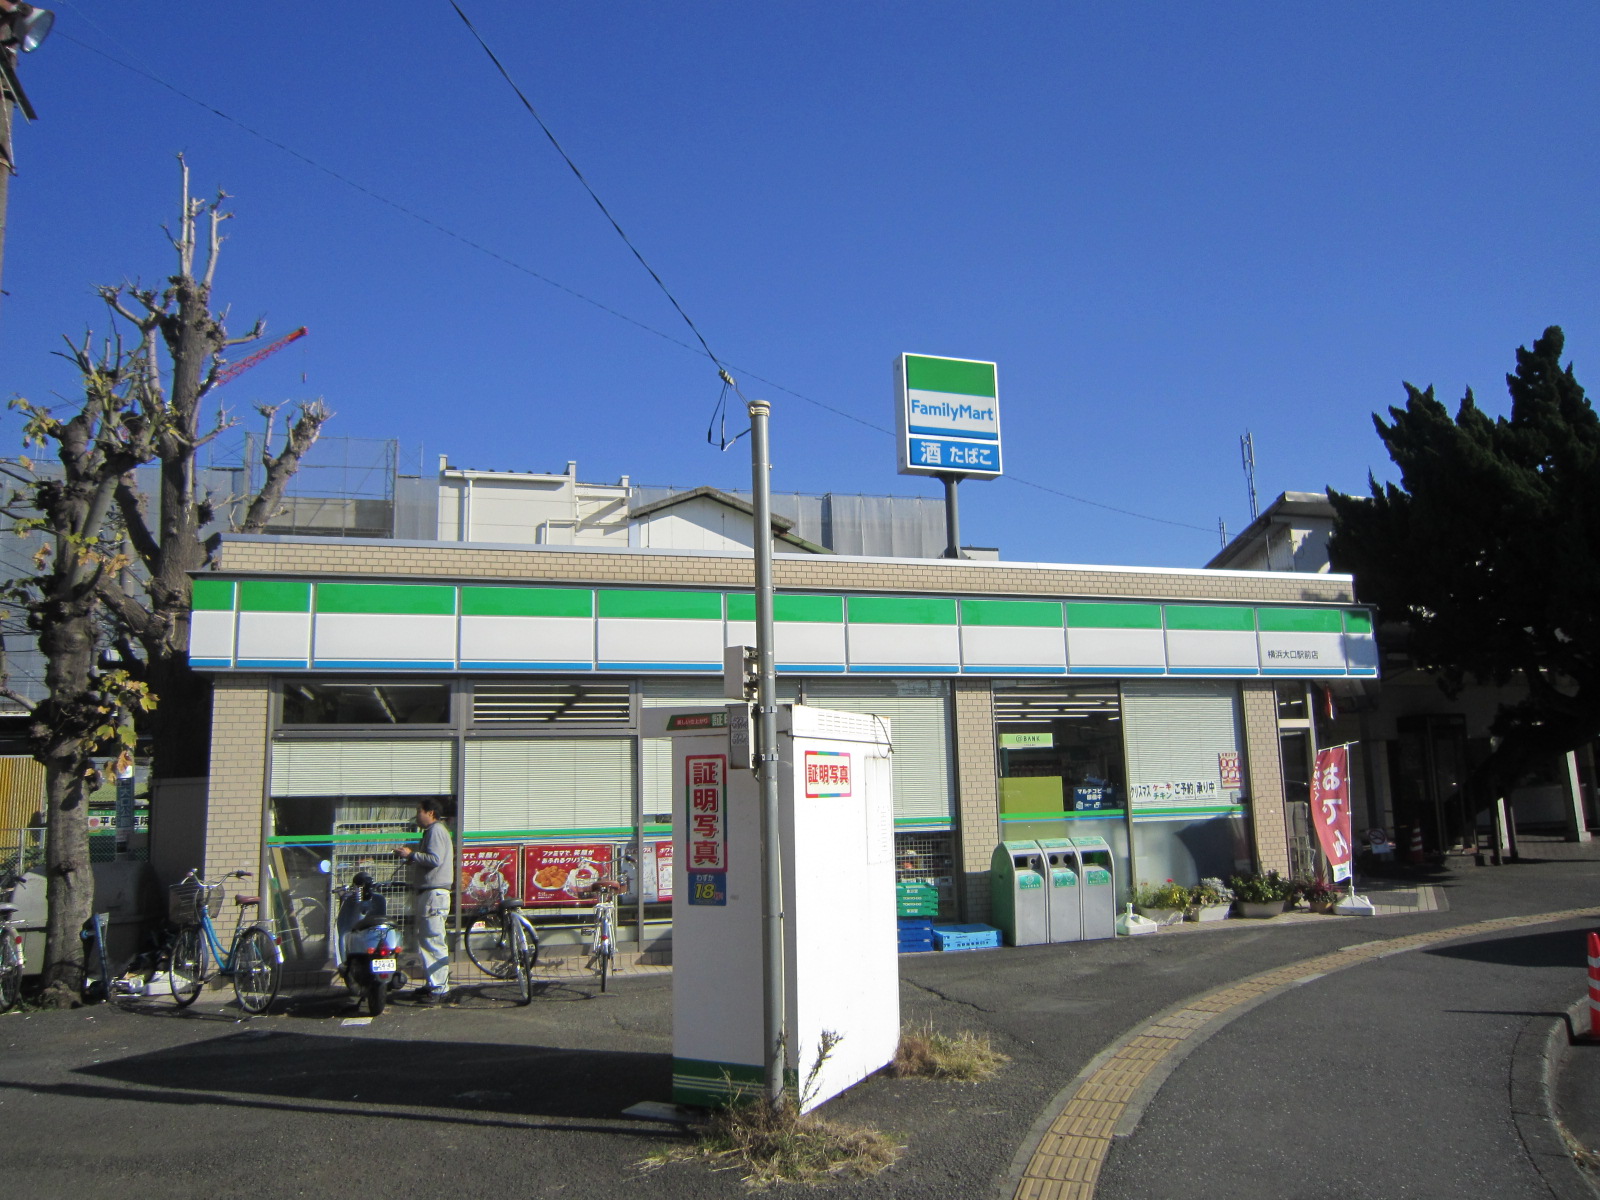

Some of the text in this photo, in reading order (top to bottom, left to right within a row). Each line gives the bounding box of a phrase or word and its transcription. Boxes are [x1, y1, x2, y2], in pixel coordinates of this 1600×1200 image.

[911, 399, 994, 421] FamilyMart
[921, 441, 992, 465] 酒 たばこ
[1267, 650, 1319, 660] 横浜大口駅前店
[808, 764, 849, 784] 証明写真
[1131, 781, 1215, 798] クリスマス ケーキ ご予約 承り中
[1153, 792, 1172, 800] チキン
[693, 762, 719, 866] 証明写真
[694, 883, 715, 899] 18
